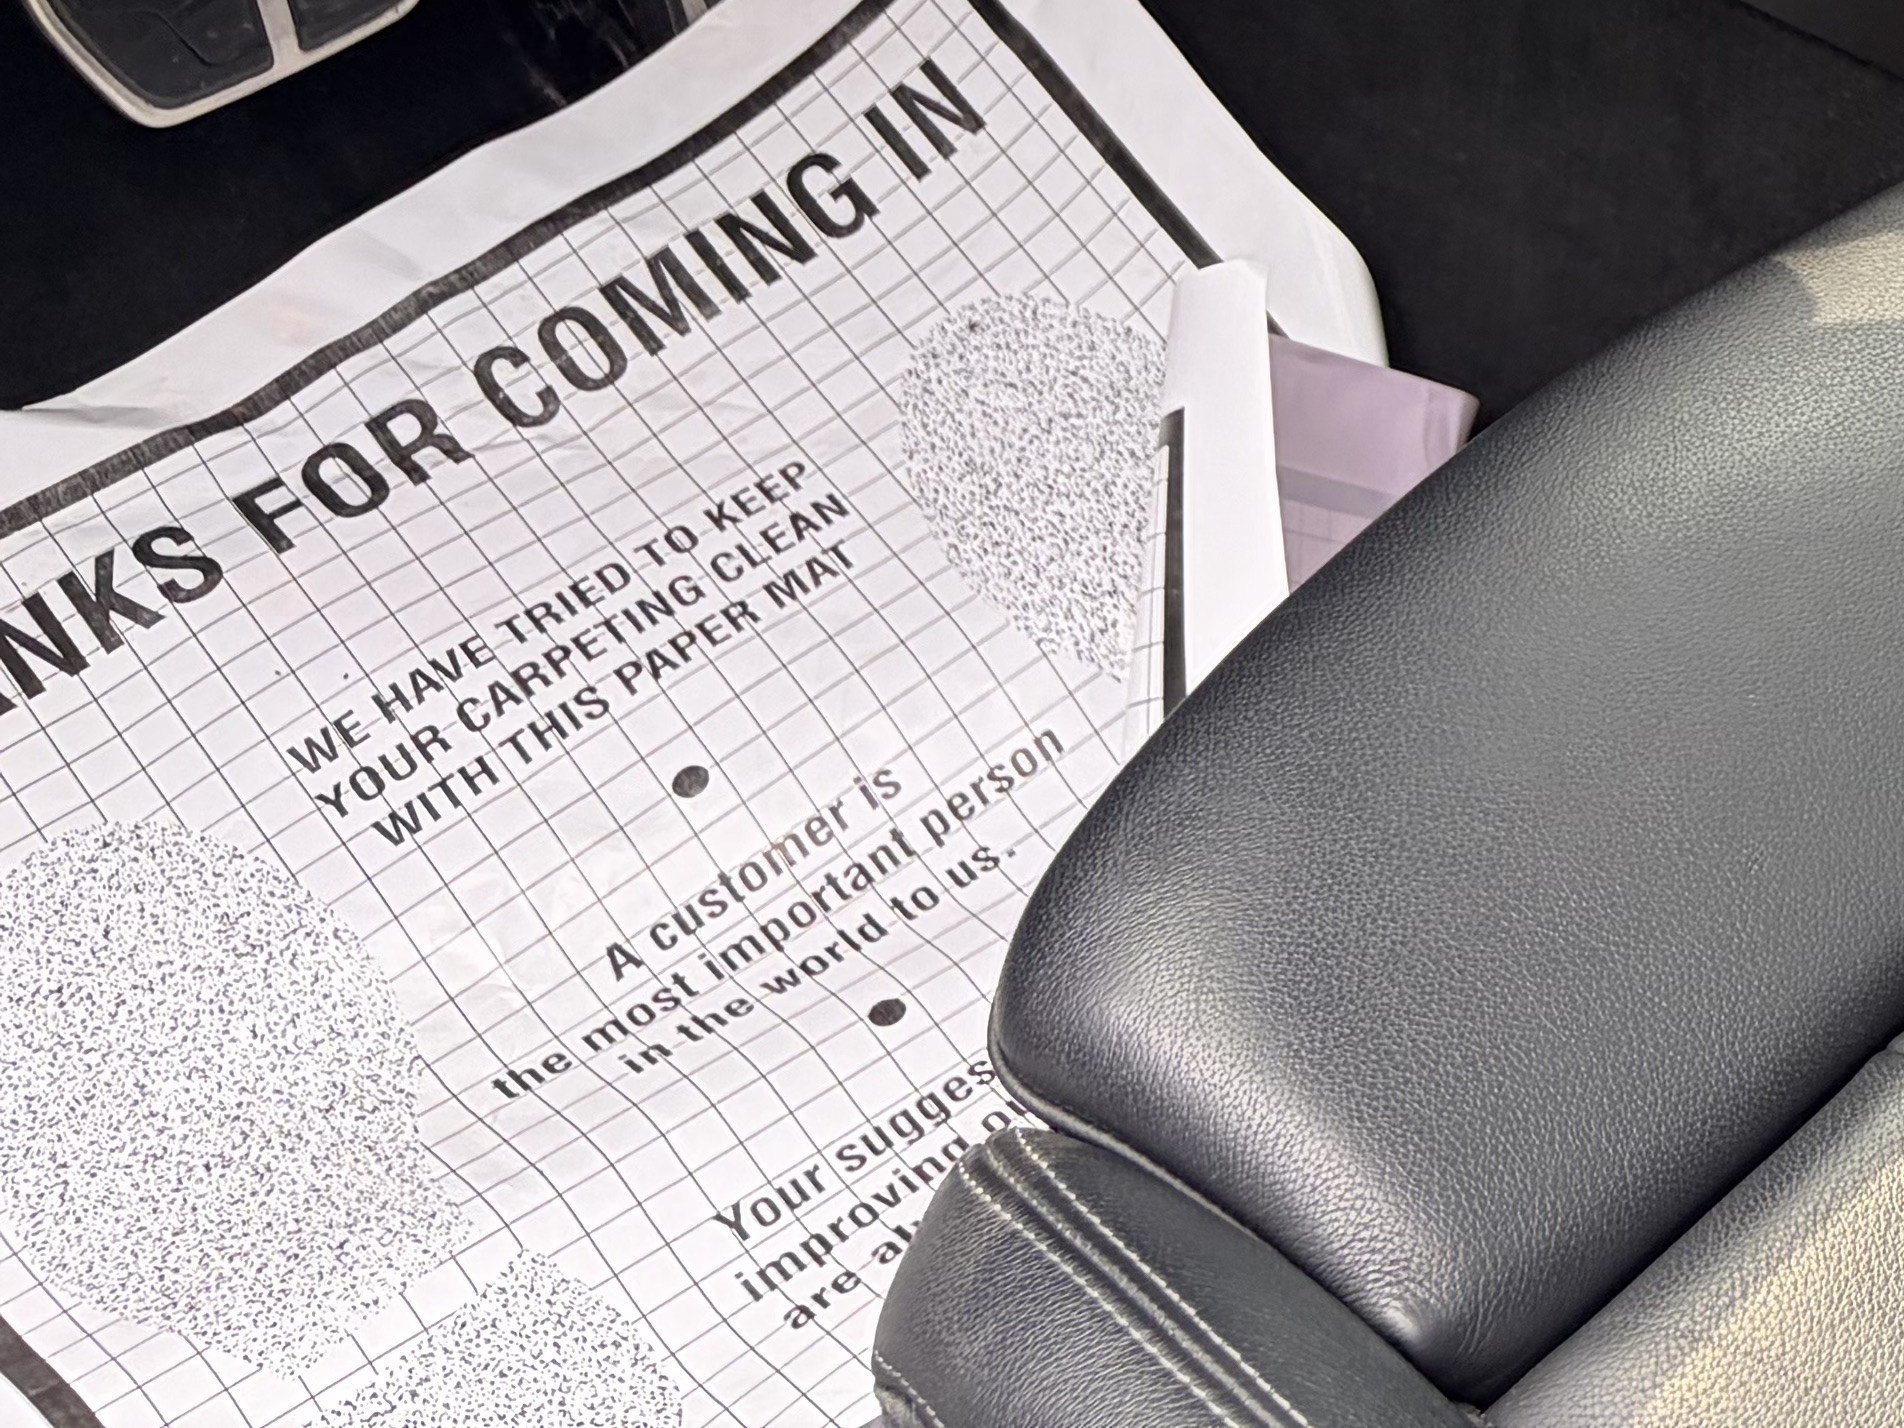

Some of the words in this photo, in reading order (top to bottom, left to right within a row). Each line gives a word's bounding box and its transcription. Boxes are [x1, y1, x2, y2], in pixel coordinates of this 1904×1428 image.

[0, 525, 224, 715] NKS
[231, 398, 476, 554] FOR
[473, 152, 880, 429] COMING
[864, 57, 987, 182] IN
[288, 710, 372, 775] WE
[372, 635, 498, 724] HAVE
[495, 561, 632, 645] TRIED
[634, 524, 701, 569] TO
[704, 460, 807, 533] KEEP
[316, 724, 453, 820] YOUR
[455, 575, 702, 734] CARPETING
[710, 493, 852, 583] CLEAN
[372, 762, 501, 848] WITH
[500, 685, 612, 766] THIS
[612, 599, 762, 697] PAPER
[762, 538, 859, 611] MAT
[491, 1048, 573, 1101] the
[581, 971, 702, 1054] most
[697, 827, 917, 982] important
[919, 727, 1066, 844] person
[604, 940, 646, 983] A
[648, 802, 861, 952] customer
[853, 765, 902, 812] is
[617, 1042, 674, 1075] in
[677, 994, 756, 1045] the
[760, 912, 890, 995] world
[890, 885, 940, 922] to
[946, 843, 1017, 890] us.
[713, 1164, 826, 1241] Your
[784, 1269, 862, 1330] are
